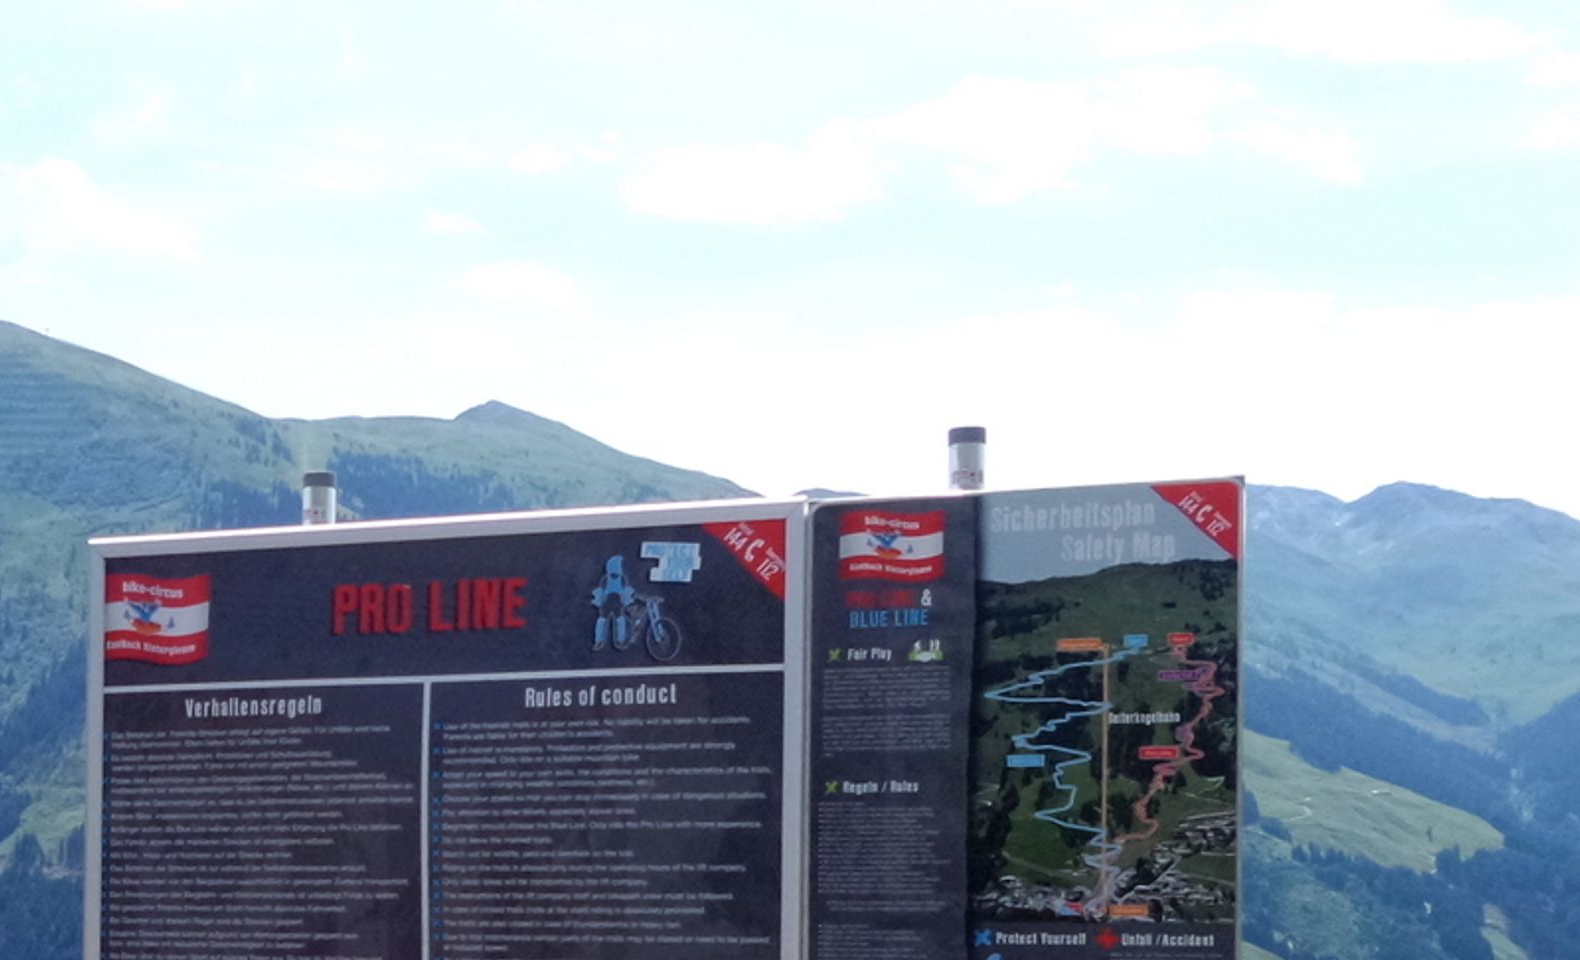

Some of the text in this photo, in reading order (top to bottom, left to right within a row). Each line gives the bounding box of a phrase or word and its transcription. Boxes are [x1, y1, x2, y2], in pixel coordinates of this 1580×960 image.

[991, 501, 1156, 533] Sicherheitsplan
[724, 527, 748, 551] 144
[757, 558, 779, 581] 112
[1061, 531, 1176, 562] Safety Map
[332, 577, 529, 636] PRO LINE
[921, 588, 932, 606] &
[849, 608, 930, 629] BLUE LINE
[848, 647, 892, 661] Fair Play
[184, 695, 323, 719] Verhaltensregeln
[525, 683, 678, 708] Rules of conduct
[996, 931, 1087, 945] Protect Yourself
